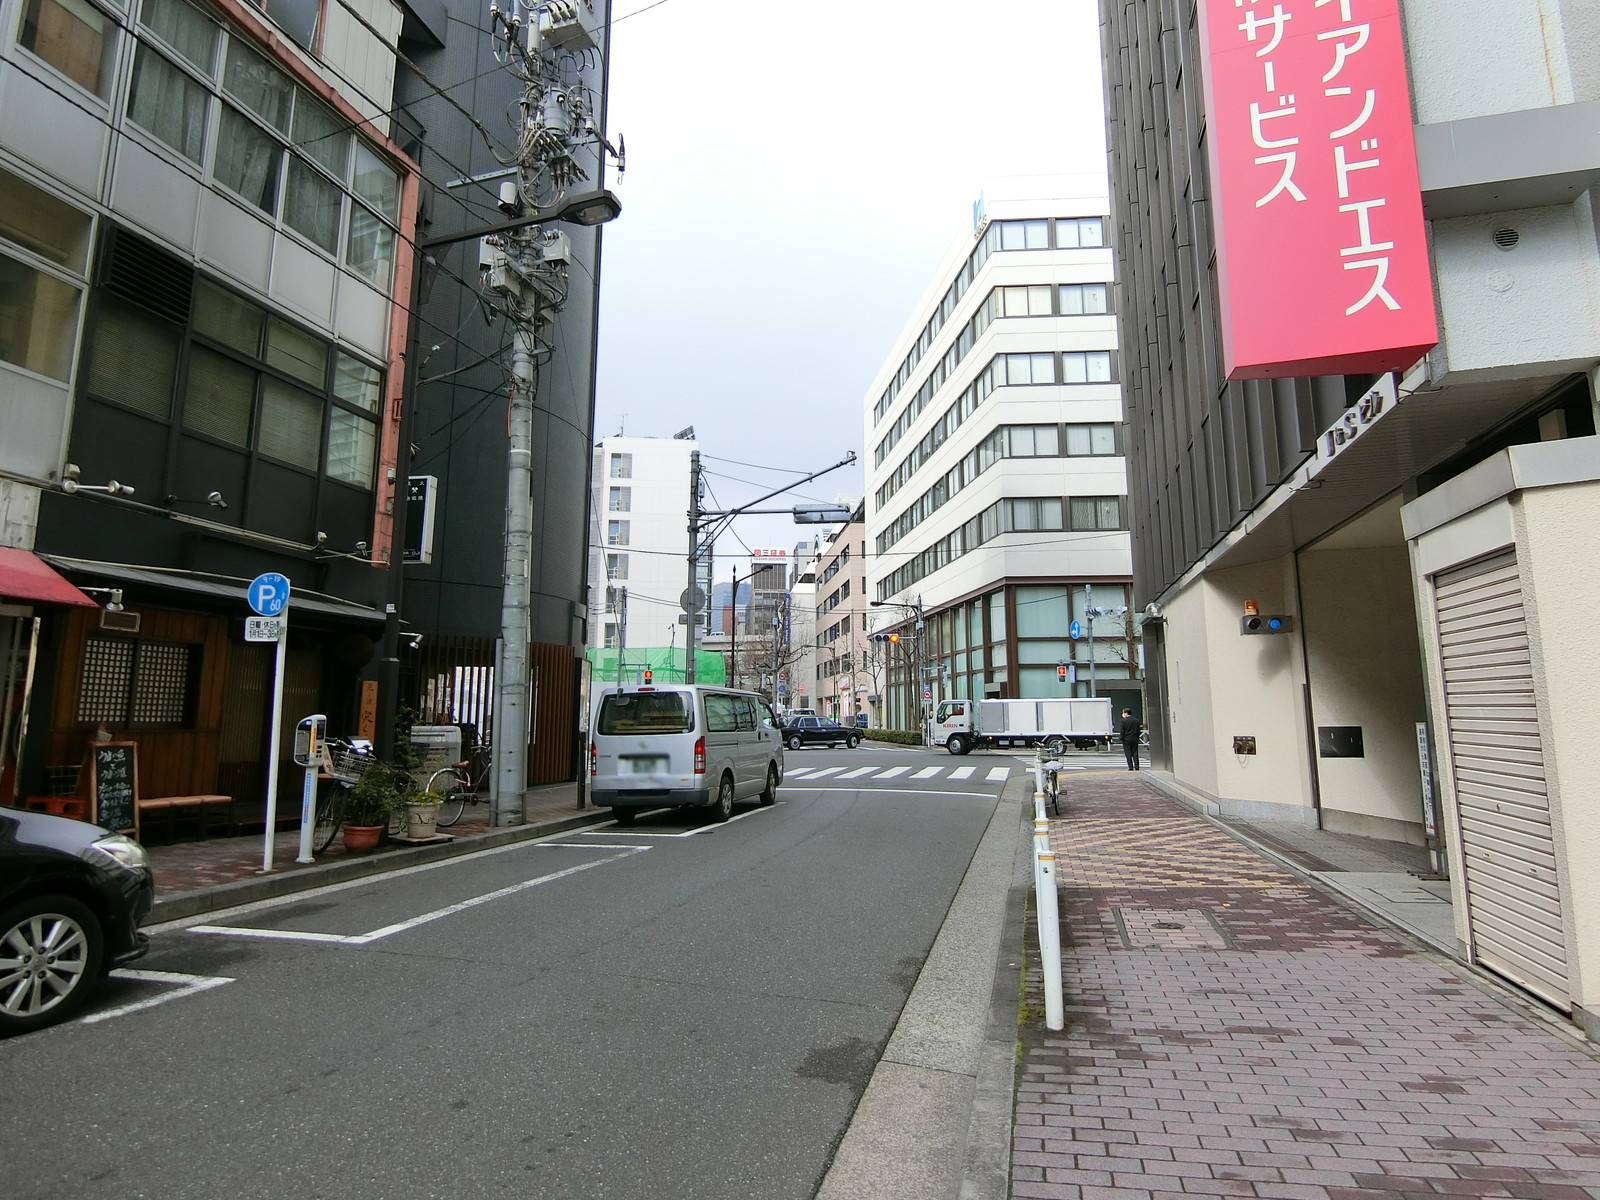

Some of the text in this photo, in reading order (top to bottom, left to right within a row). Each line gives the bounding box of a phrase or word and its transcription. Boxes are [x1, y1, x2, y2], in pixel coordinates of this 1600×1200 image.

[1235, 0, 1307, 208] サービス
[258, 585, 276, 612] P
[270, 599, 281, 611] 60
